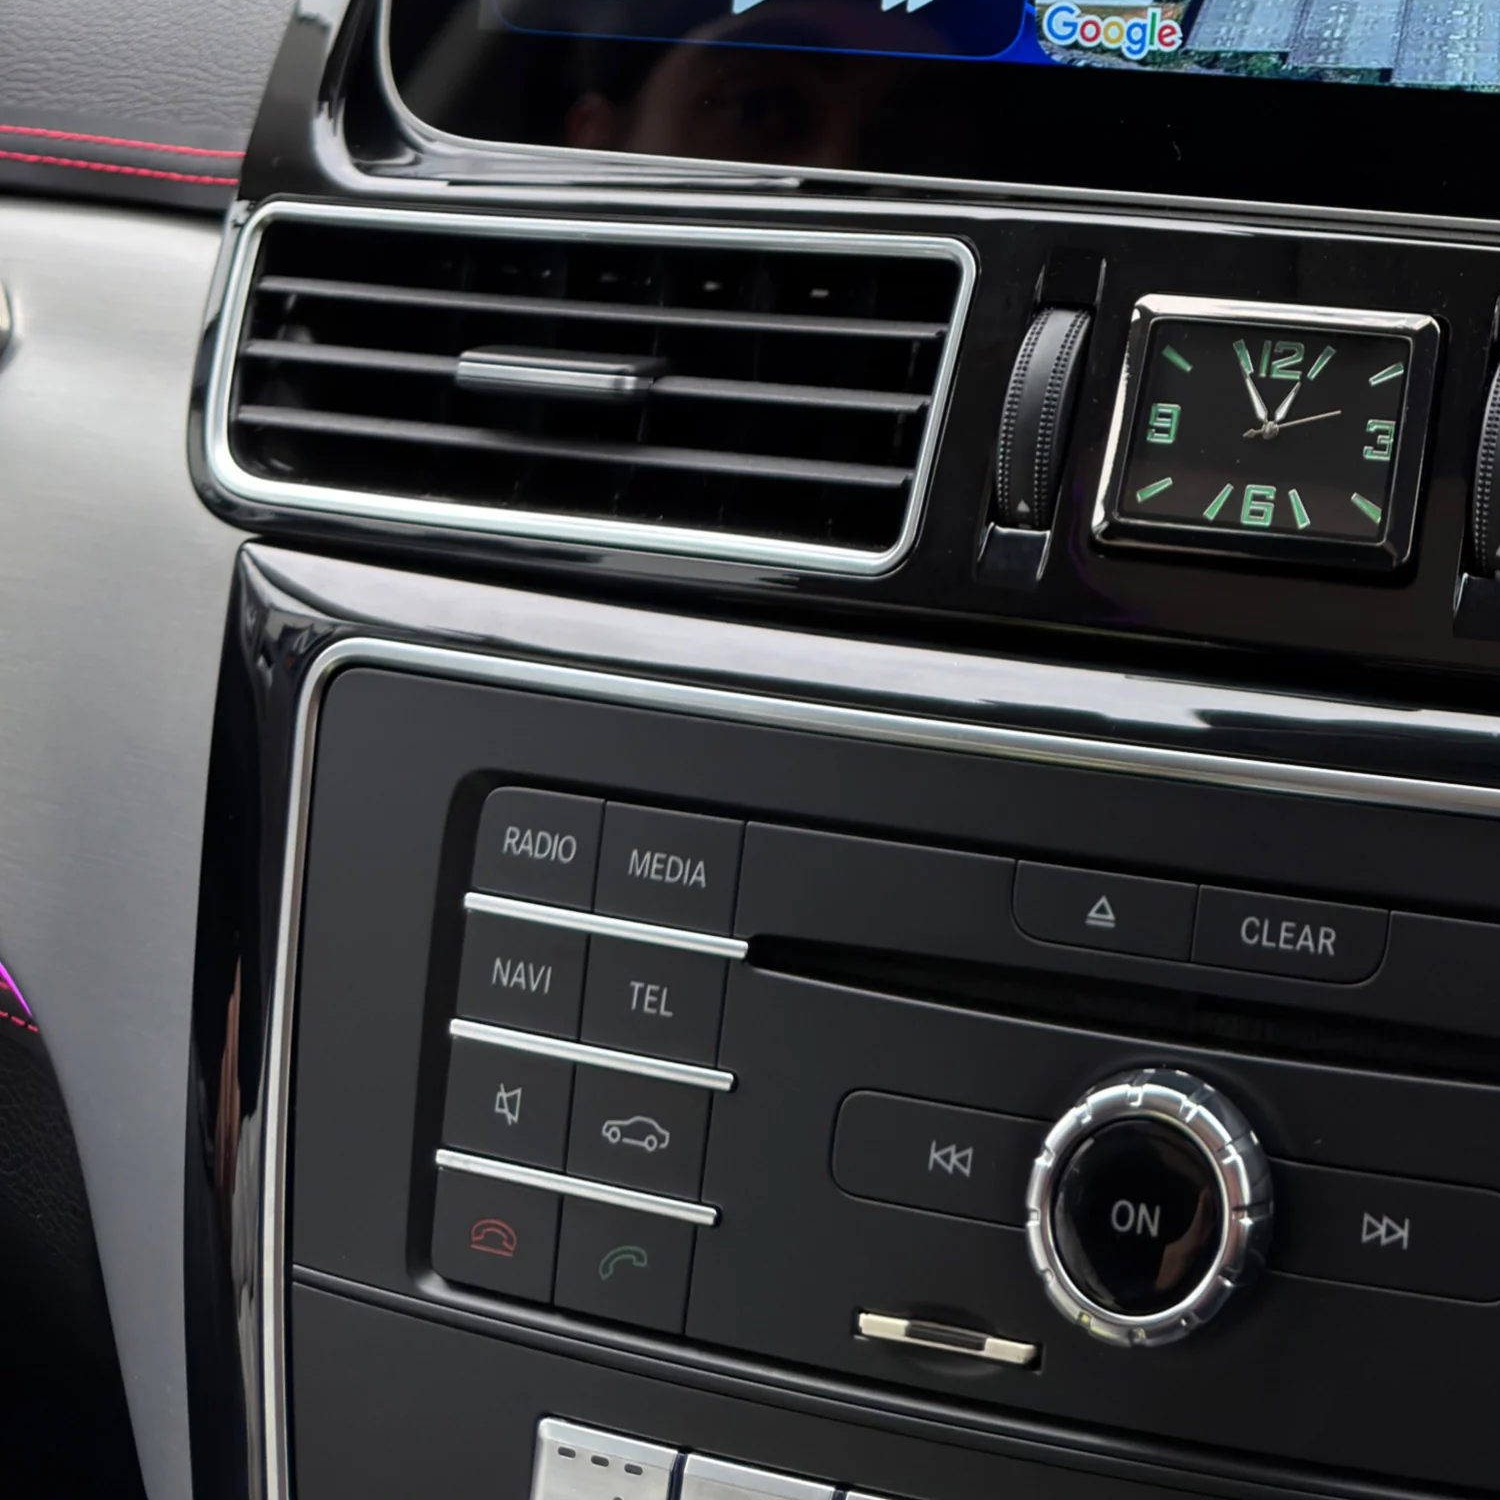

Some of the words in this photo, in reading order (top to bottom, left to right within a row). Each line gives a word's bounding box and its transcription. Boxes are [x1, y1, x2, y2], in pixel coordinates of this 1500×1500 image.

[1044, 4, 1181, 58] Google
[1258, 340, 1305, 380] 12
[1147, 403, 1181, 444] 9
[1363, 419, 1396, 461] 3
[1240, 484, 1276, 527] 6
[503, 825, 577, 864] RADIO
[628, 849, 707, 889] MEDIA
[1240, 916, 1337, 957] CLEAR
[491, 957, 552, 994] NAVI
[629, 980, 674, 1018] TEL
[1111, 1199, 1161, 1237] ON
